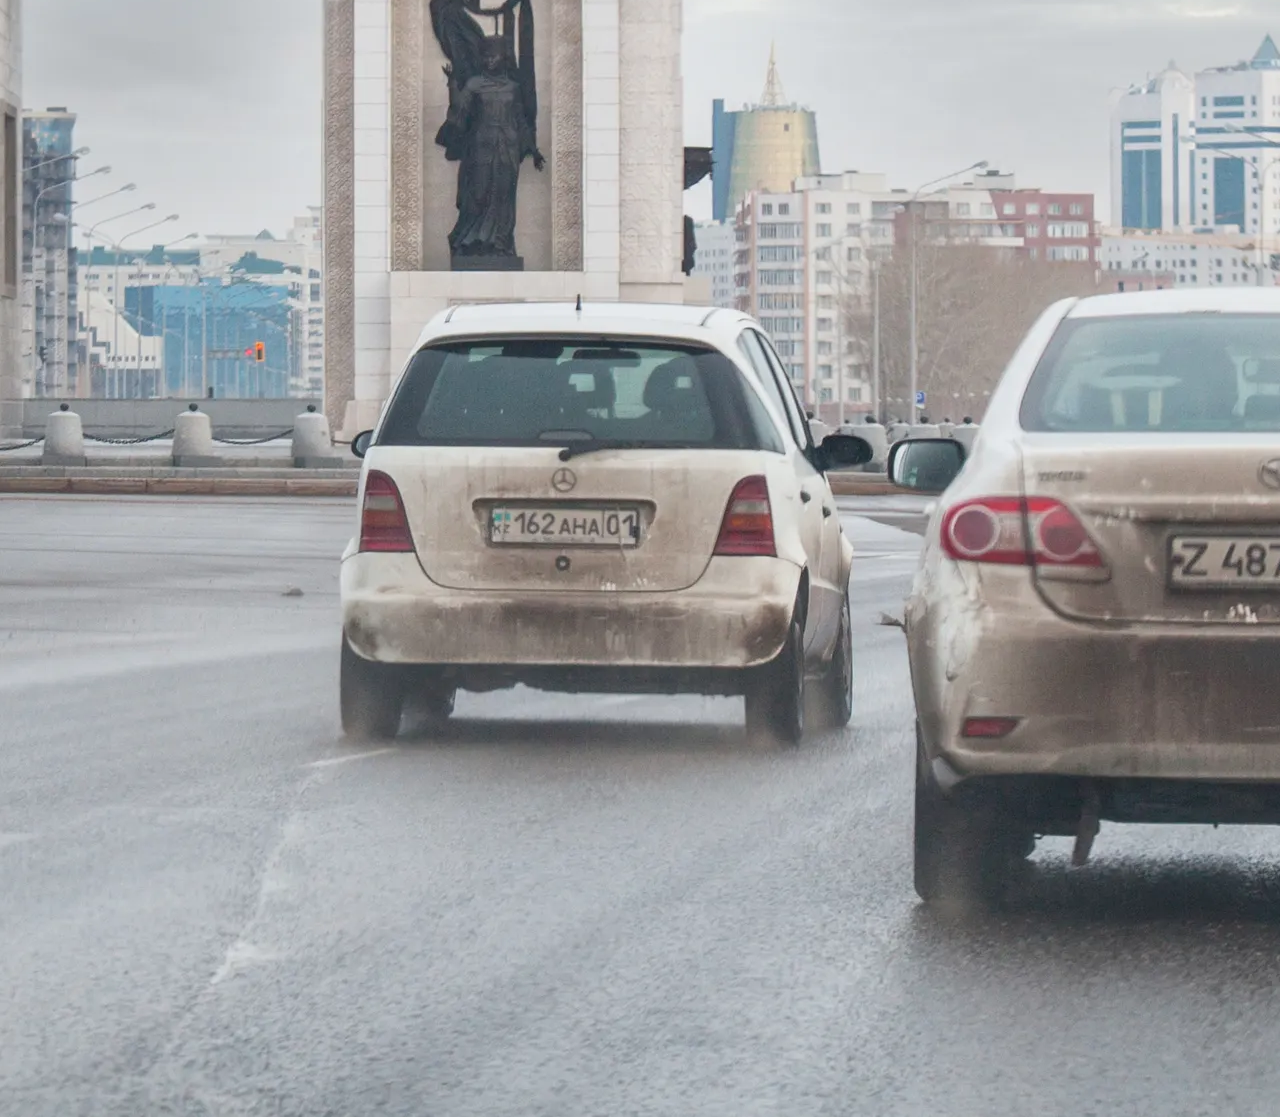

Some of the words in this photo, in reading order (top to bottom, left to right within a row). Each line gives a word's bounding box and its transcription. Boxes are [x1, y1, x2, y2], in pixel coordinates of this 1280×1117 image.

[513, 511, 556, 535] 162
[558, 517, 600, 536] AHA
[605, 513, 636, 536] 01
[1181, 542, 1208, 576] Z
